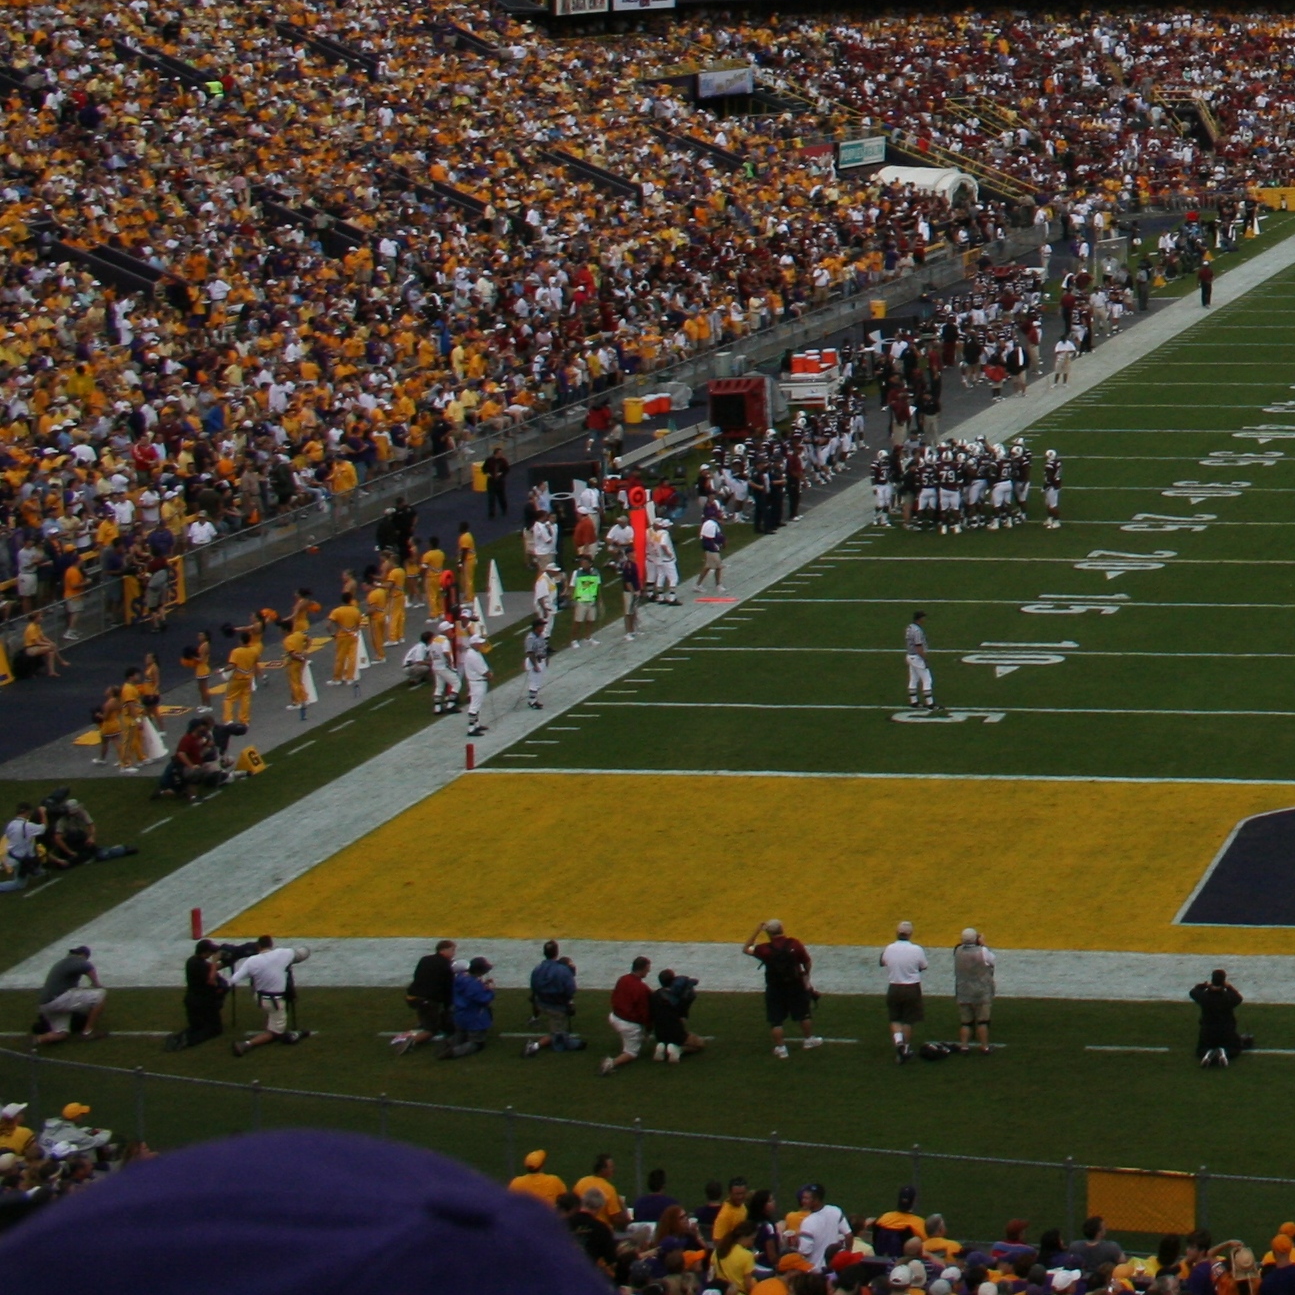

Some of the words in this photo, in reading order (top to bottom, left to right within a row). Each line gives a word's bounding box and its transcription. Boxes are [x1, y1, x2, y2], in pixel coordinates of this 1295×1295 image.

[940, 470, 956, 483] 79
[1161, 481, 1252, 497] 30
[1120, 513, 1218, 532] 25
[1073, 549, 1179, 571] 20
[1020, 593, 1132, 615] 15
[961, 640, 1080, 665] 10
[891, 709, 1007, 724] 5
[249, 751, 261, 767] G
